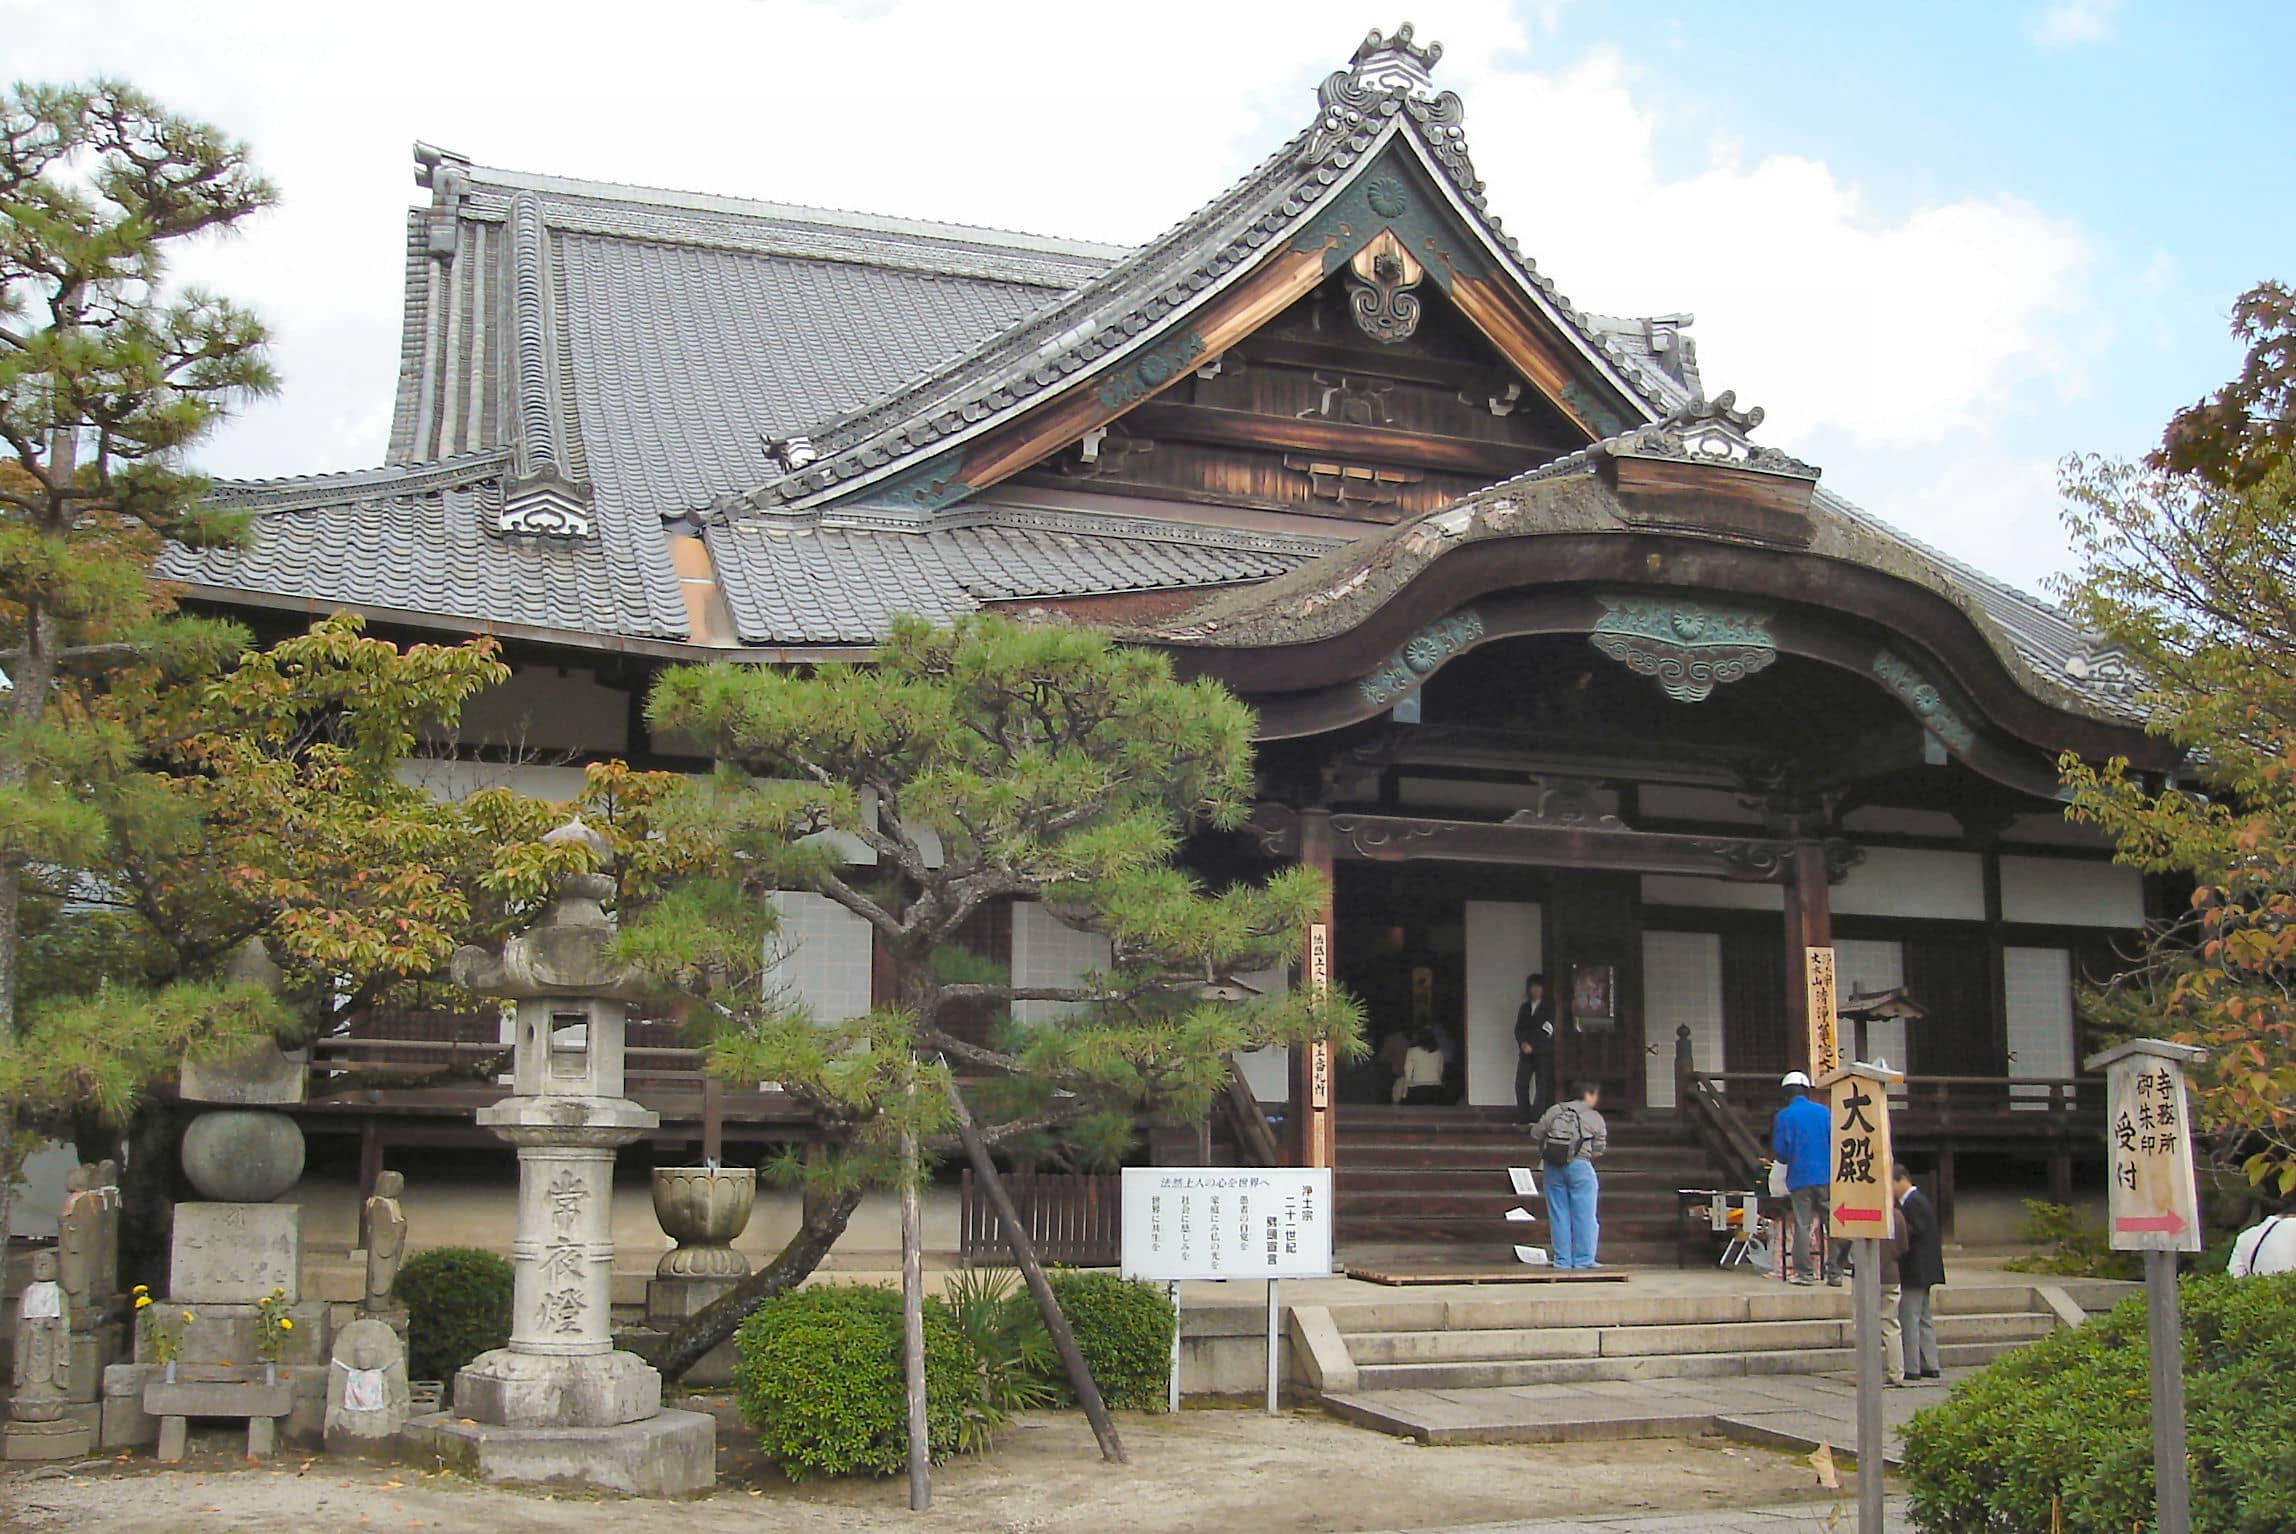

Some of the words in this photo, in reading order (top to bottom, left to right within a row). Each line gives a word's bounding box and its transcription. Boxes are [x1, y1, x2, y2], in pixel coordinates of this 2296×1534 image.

[1835, 1081, 1877, 1184] 大殿
[2114, 1111, 2138, 1191] 受付
[2136, 1073, 2156, 1157] 御朱印
[2156, 1067, 2177, 1155] 寺務所
[1160, 1176, 1271, 1189] 法然上人の心を世界へ
[1302, 1184, 1314, 1221] 浄土宗
[1284, 1196, 1297, 1254] 二十一世紀
